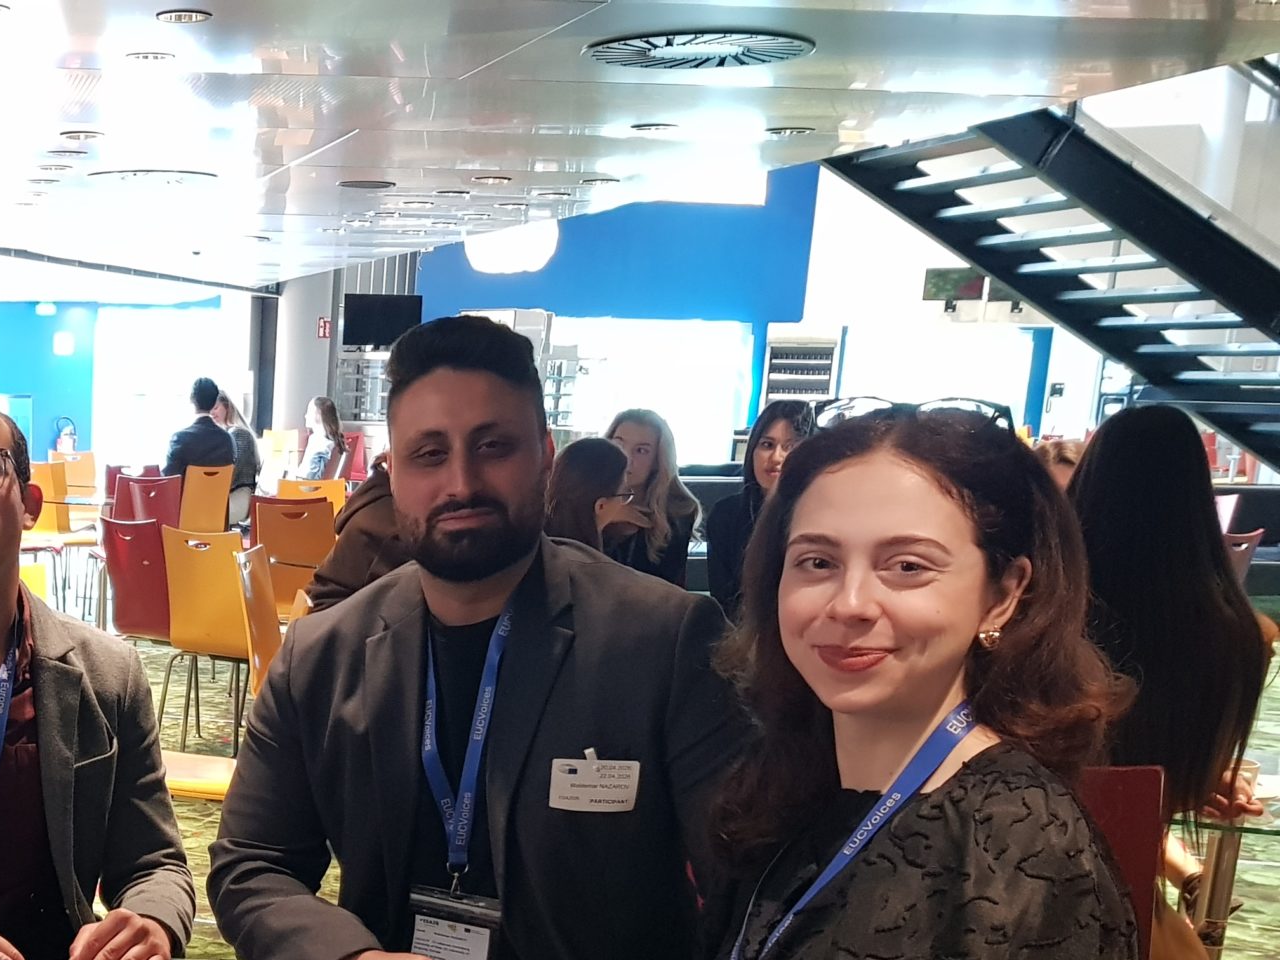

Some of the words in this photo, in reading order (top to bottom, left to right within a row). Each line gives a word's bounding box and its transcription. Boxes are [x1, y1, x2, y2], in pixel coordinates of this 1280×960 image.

[474, 686, 491, 740] EUCVoices
[455, 792, 472, 846] EUCVoices
[843, 792, 902, 856] EUCVoices
